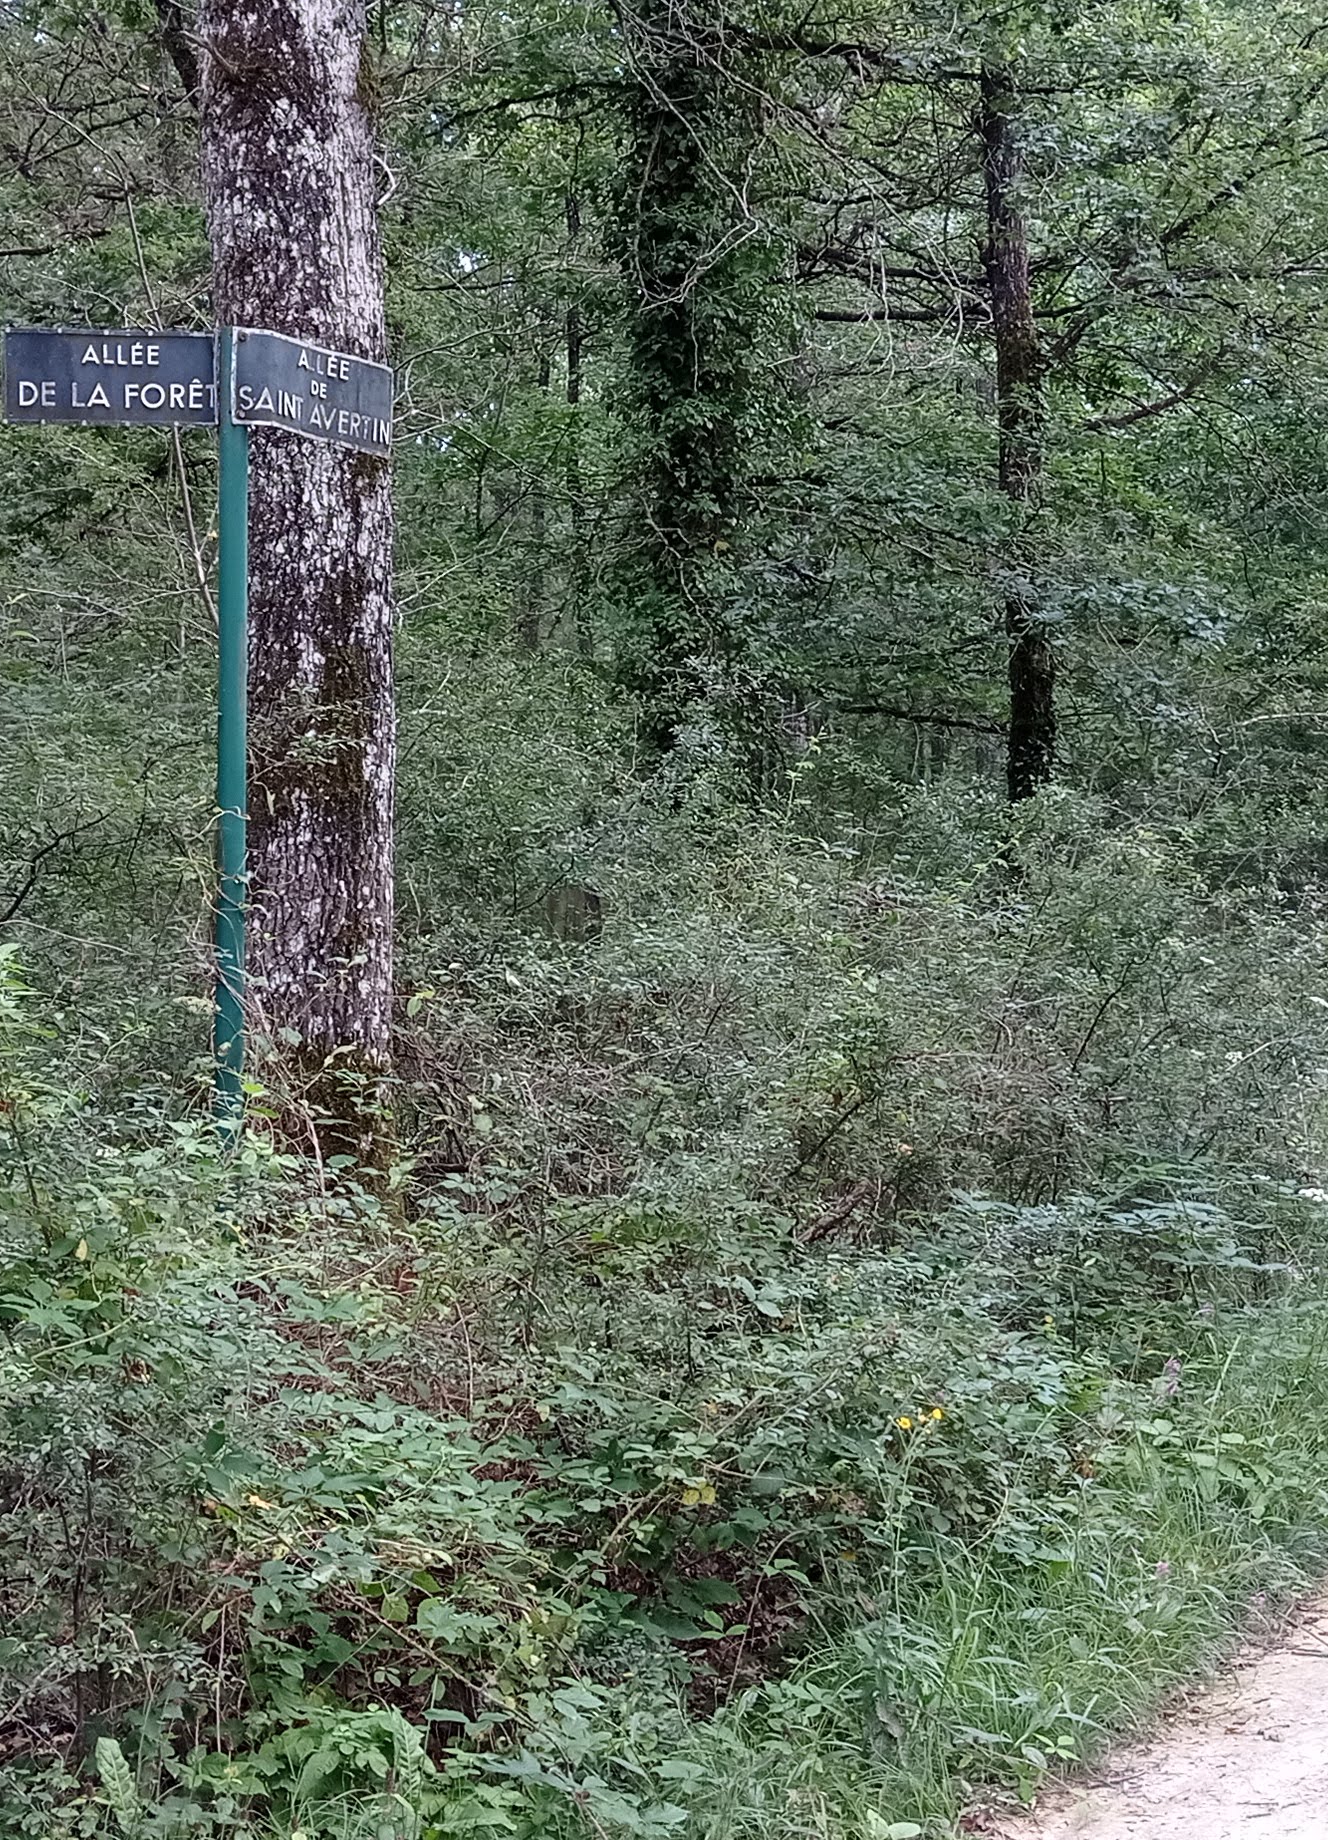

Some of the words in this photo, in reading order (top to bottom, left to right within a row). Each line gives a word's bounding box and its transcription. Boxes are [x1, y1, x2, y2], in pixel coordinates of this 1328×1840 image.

[81, 342, 160, 366] ALLÉE
[18, 380, 56, 408] DE
[71, 382, 110, 408] LA
[124, 378, 215, 409] FORÊT
[310, 379, 328, 399] DE
[238, 385, 304, 419] SAINT
[309, 402, 390, 445] AVERTIN
